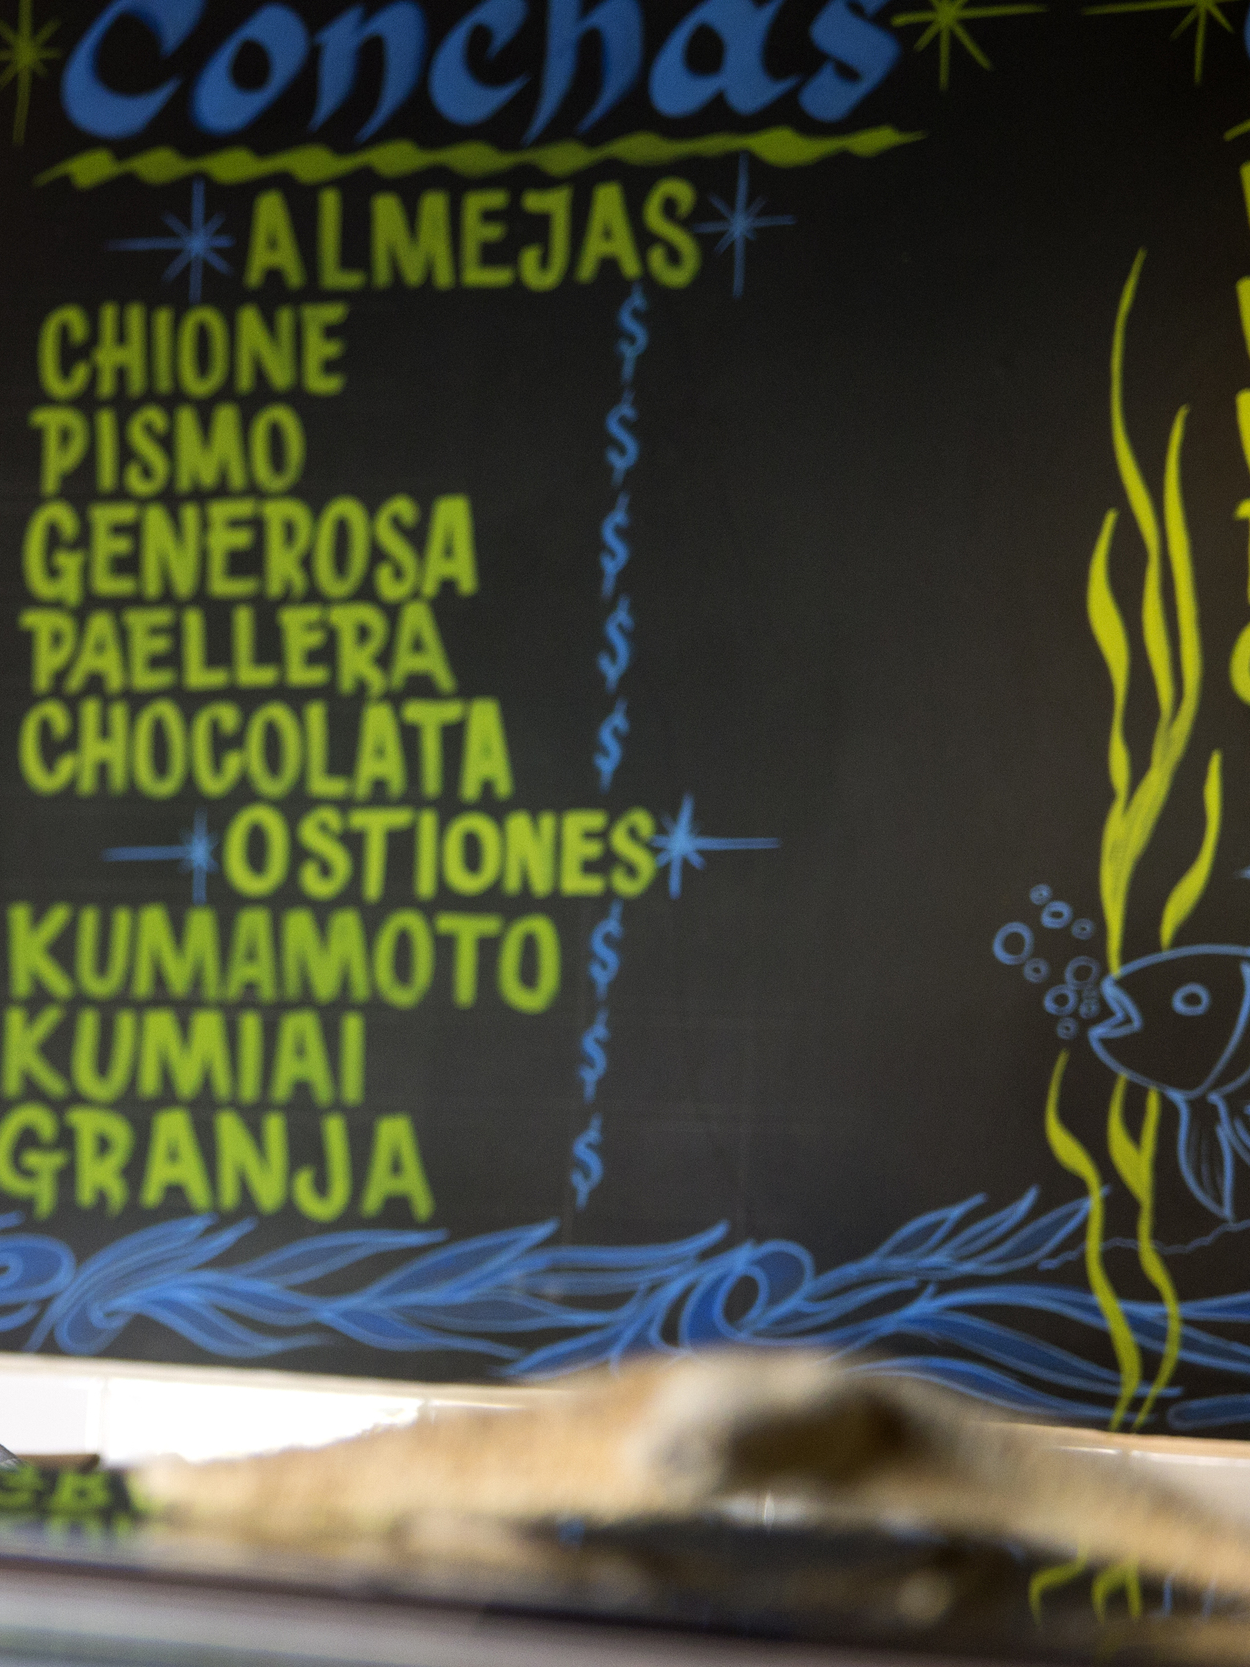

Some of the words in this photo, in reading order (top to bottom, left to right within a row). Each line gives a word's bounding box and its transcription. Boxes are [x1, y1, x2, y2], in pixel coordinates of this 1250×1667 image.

[61, 0, 901, 141] Conchas
[244, 178, 700, 291] ALMEJAS
[38, 303, 346, 400] CHIONE
[30, 403, 305, 498] PISMO
[23, 493, 478, 607] GENEROSA
[19, 601, 456, 700] PAELLERA
[19, 695, 513, 801] CHOCOLATA
[222, 802, 657, 903] OSTIONES
[6, 902, 561, 1013] KUMAMOTO
[1, 1004, 365, 1105] KUMIAI
